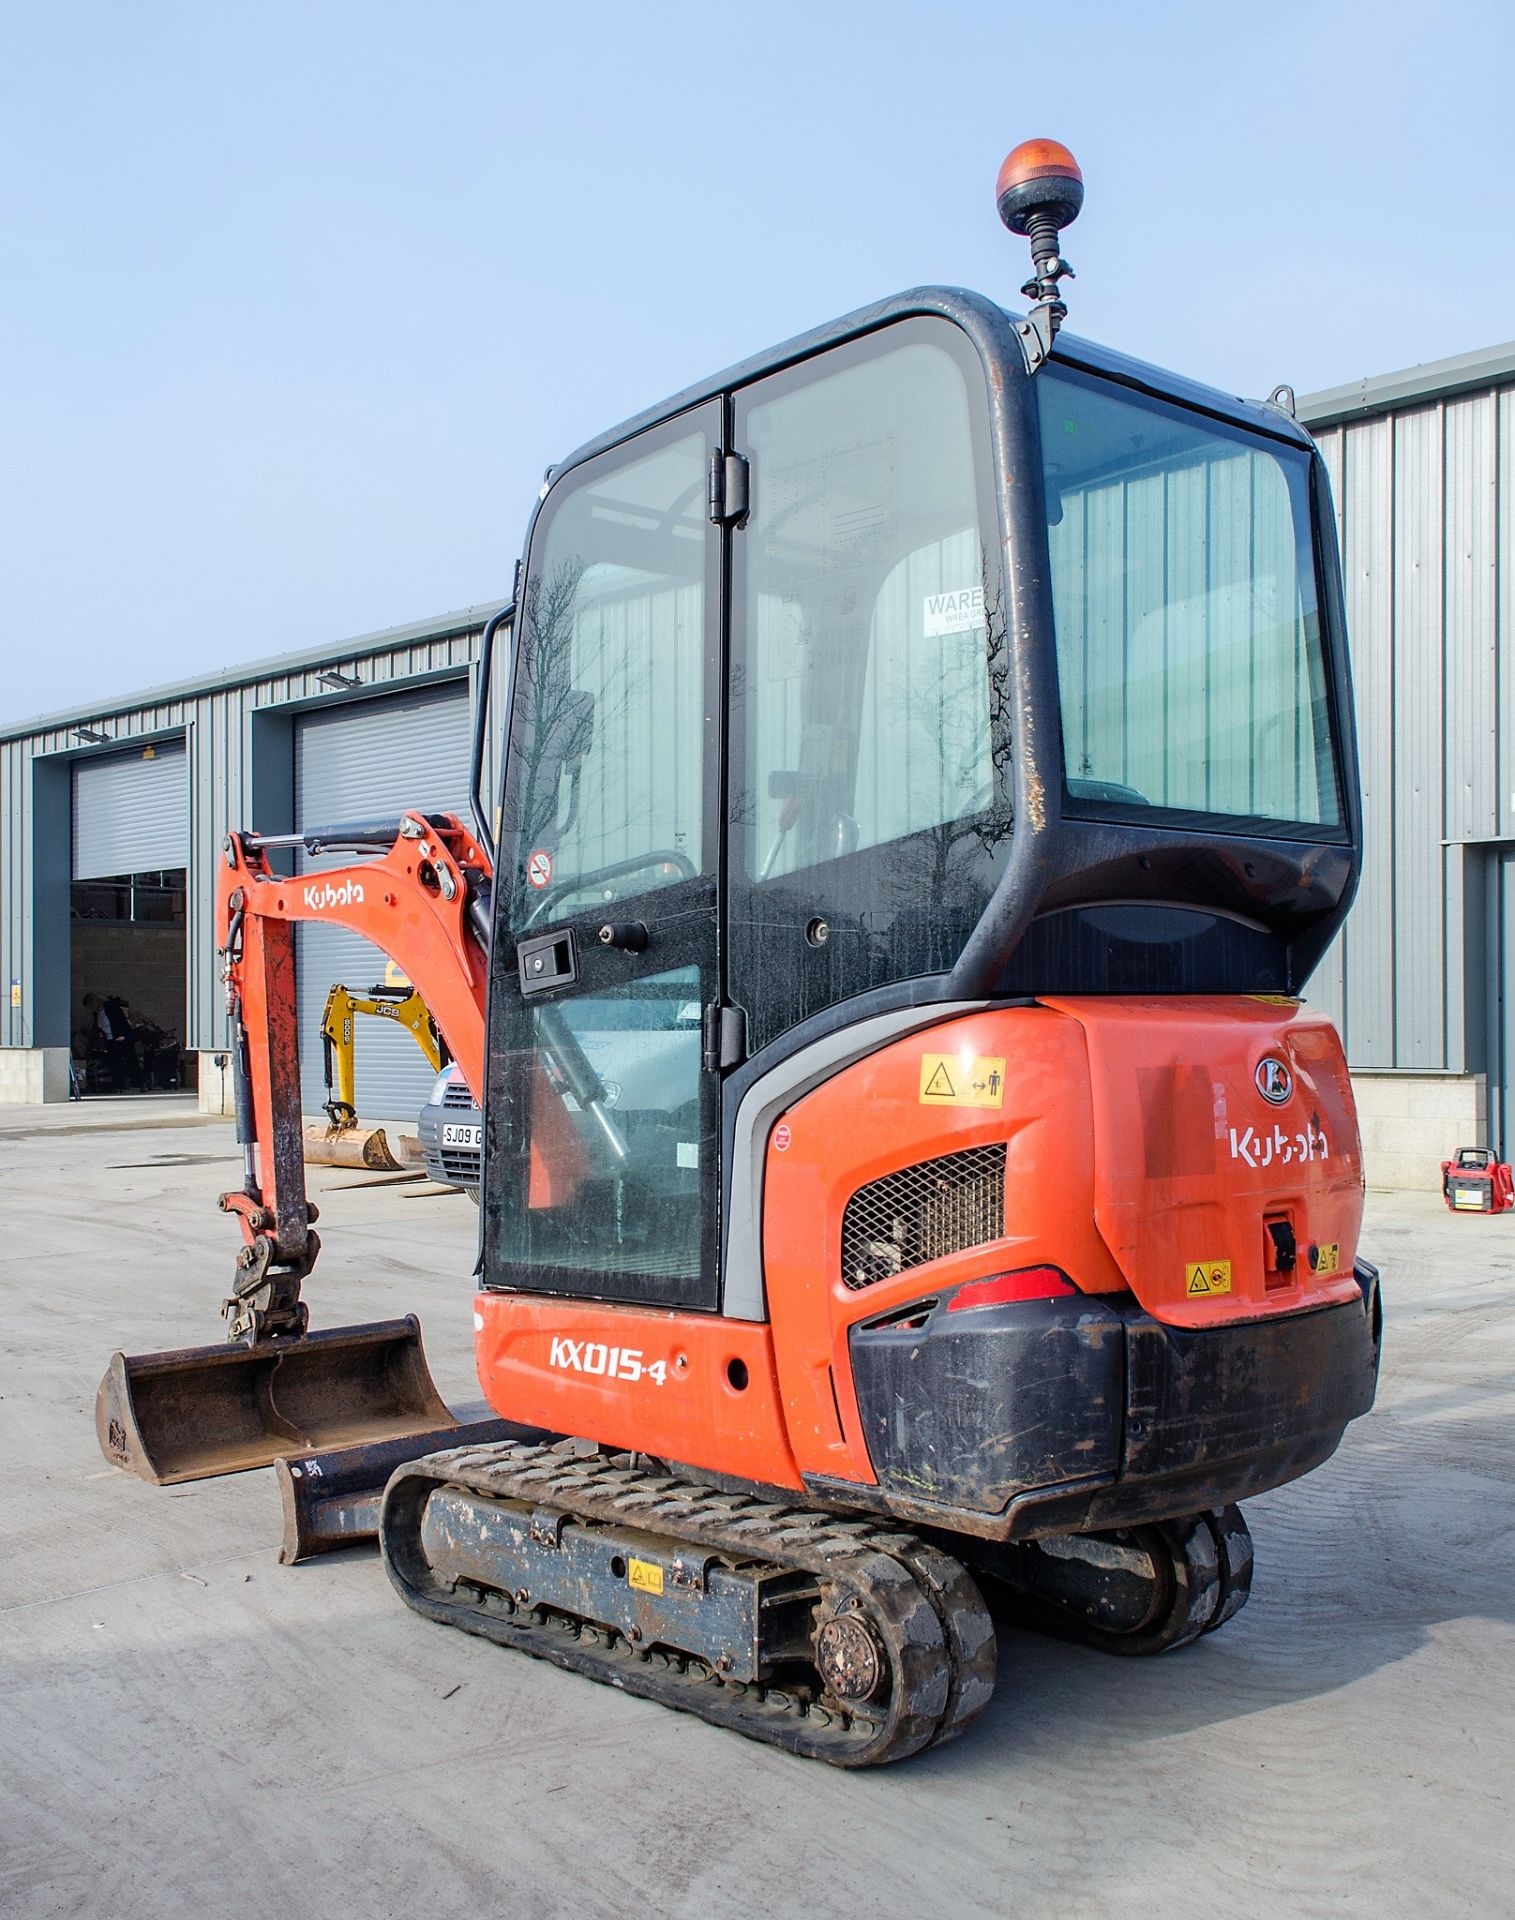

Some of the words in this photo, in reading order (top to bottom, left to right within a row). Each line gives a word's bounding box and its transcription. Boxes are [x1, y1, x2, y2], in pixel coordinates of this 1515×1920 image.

[303, 879, 365, 911] Kubota
[376, 1006, 400, 1017] JCB
[446, 1127, 472, 1144] SJ09
[1229, 1122, 1329, 1168] Kubota
